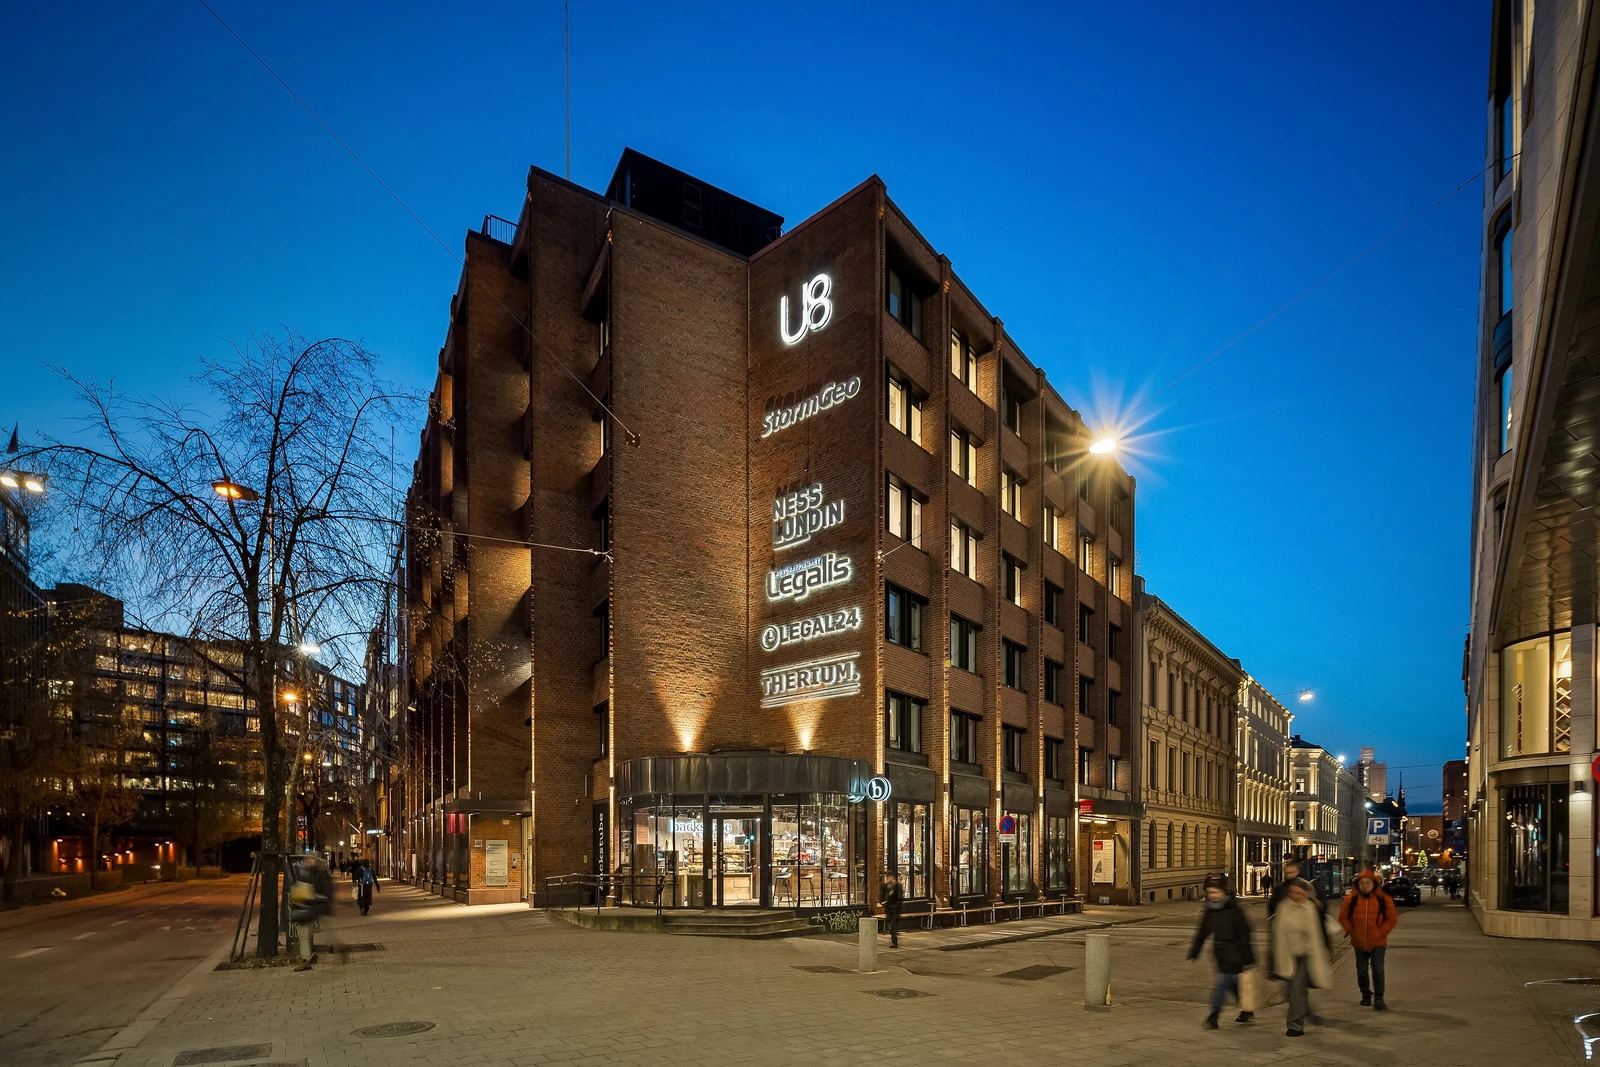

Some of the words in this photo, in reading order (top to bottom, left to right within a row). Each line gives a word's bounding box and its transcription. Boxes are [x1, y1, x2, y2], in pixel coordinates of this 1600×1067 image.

[780, 273, 832, 345] U8
[761, 376, 861, 438] StormGeo
[773, 483, 822, 521] NESS
[773, 500, 844, 545] LUNDIN
[766, 553, 851, 601] Legalis
[780, 608, 860, 645] LEGAL24
[761, 662, 860, 696] THERIUM.
[1373, 820, 1385, 834] P
